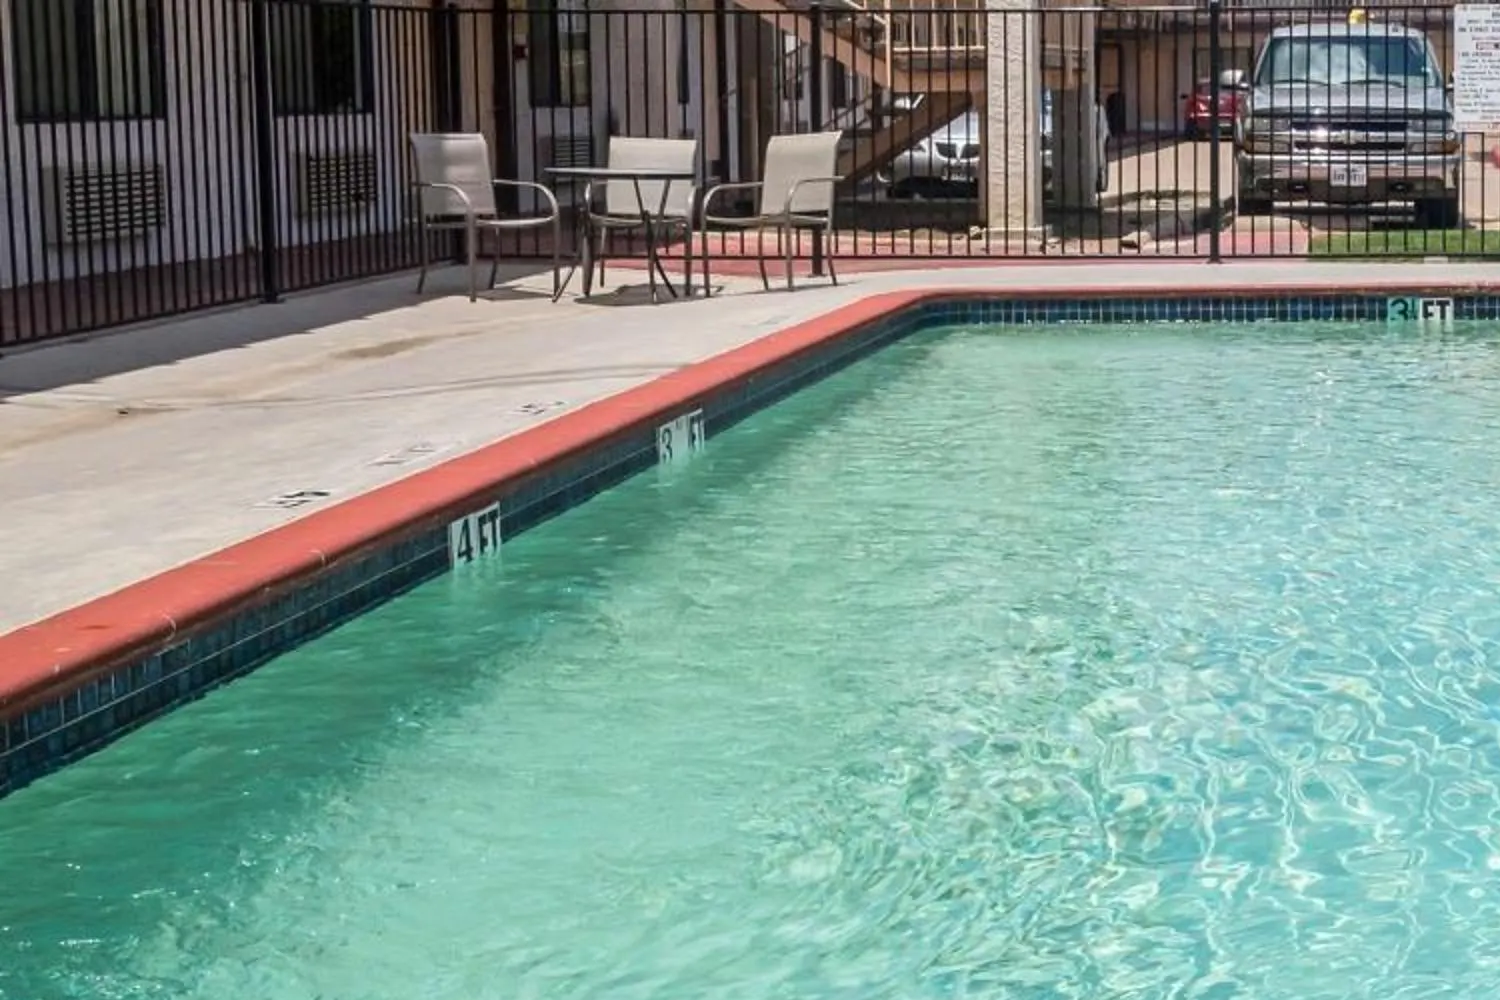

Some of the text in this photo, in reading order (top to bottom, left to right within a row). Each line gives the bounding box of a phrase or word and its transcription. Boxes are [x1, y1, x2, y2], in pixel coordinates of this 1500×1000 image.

[1422, 300, 1451, 320] FT
[457, 508, 499, 563] 4 FT
